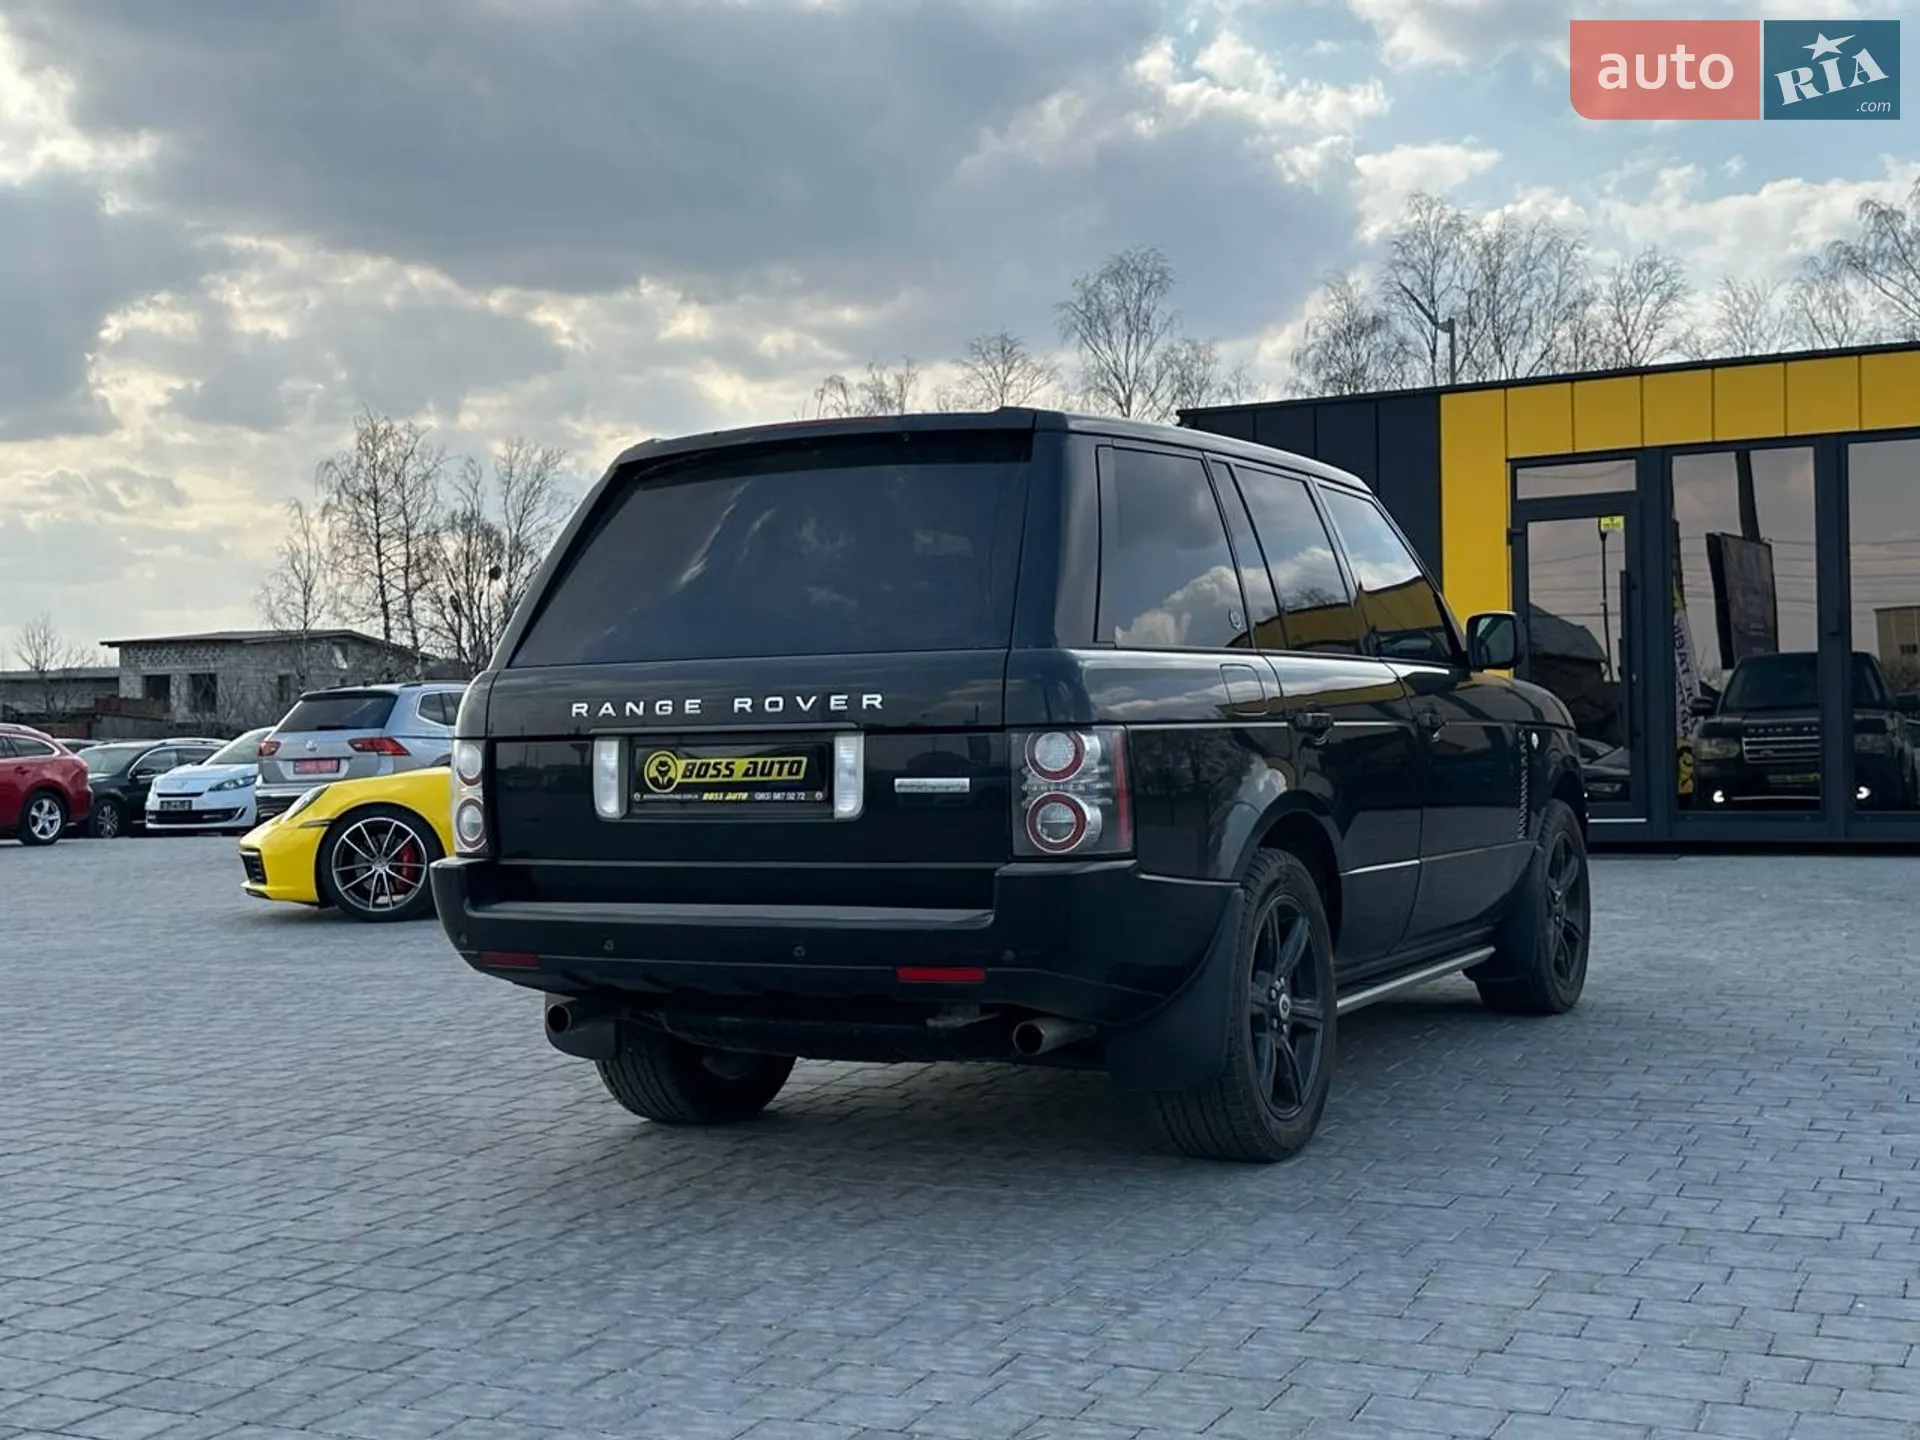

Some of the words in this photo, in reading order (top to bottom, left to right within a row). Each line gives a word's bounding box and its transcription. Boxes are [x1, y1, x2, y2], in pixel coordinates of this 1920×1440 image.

[571, 699, 702, 717] RANGE
[734, 693, 883, 713] ROVER
[681, 760, 735, 779] BOSS
[742, 759, 803, 777] AUTO
[702, 792, 722, 800] BOSS
[725, 792, 748, 800] AUTO
